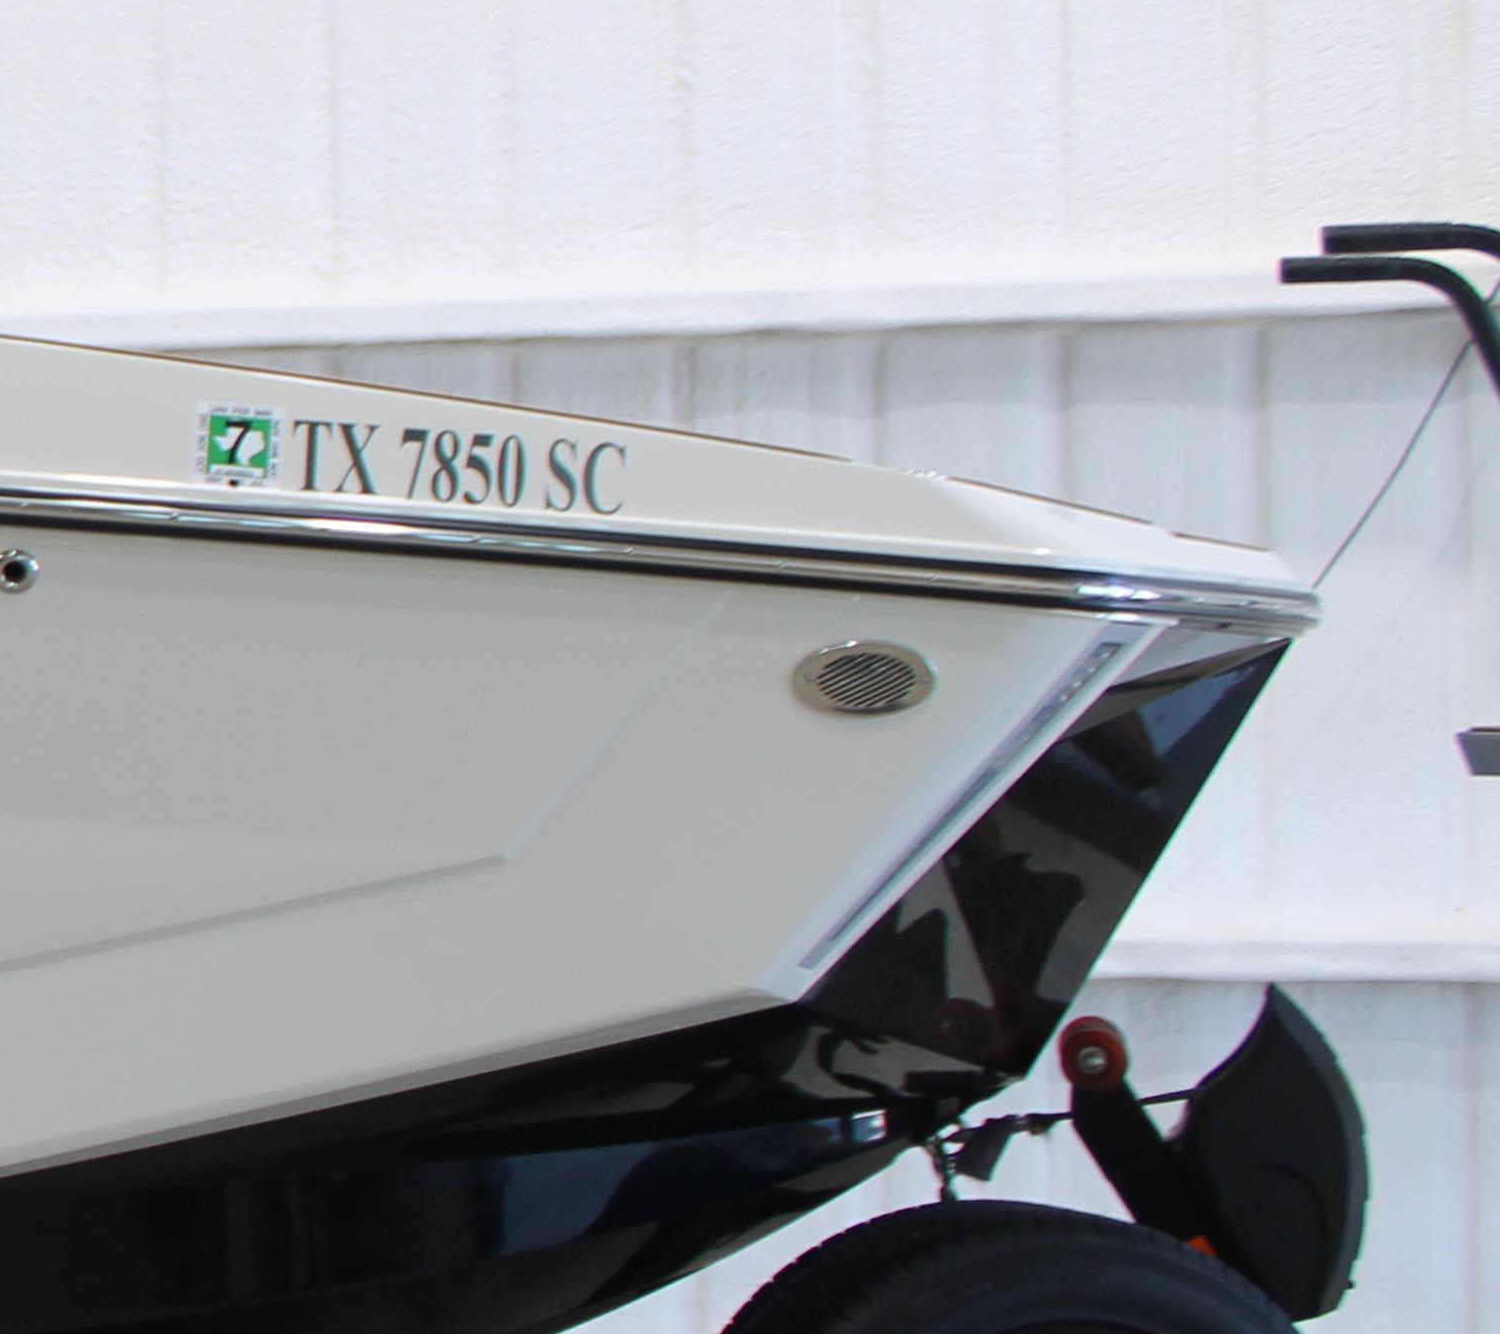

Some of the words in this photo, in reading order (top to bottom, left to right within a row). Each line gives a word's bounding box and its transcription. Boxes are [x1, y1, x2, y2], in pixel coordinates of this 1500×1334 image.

[225, 420, 253, 464] 7
[294, 419, 382, 494] TX
[400, 428, 528, 508] 7850
[545, 438, 628, 515] SC
